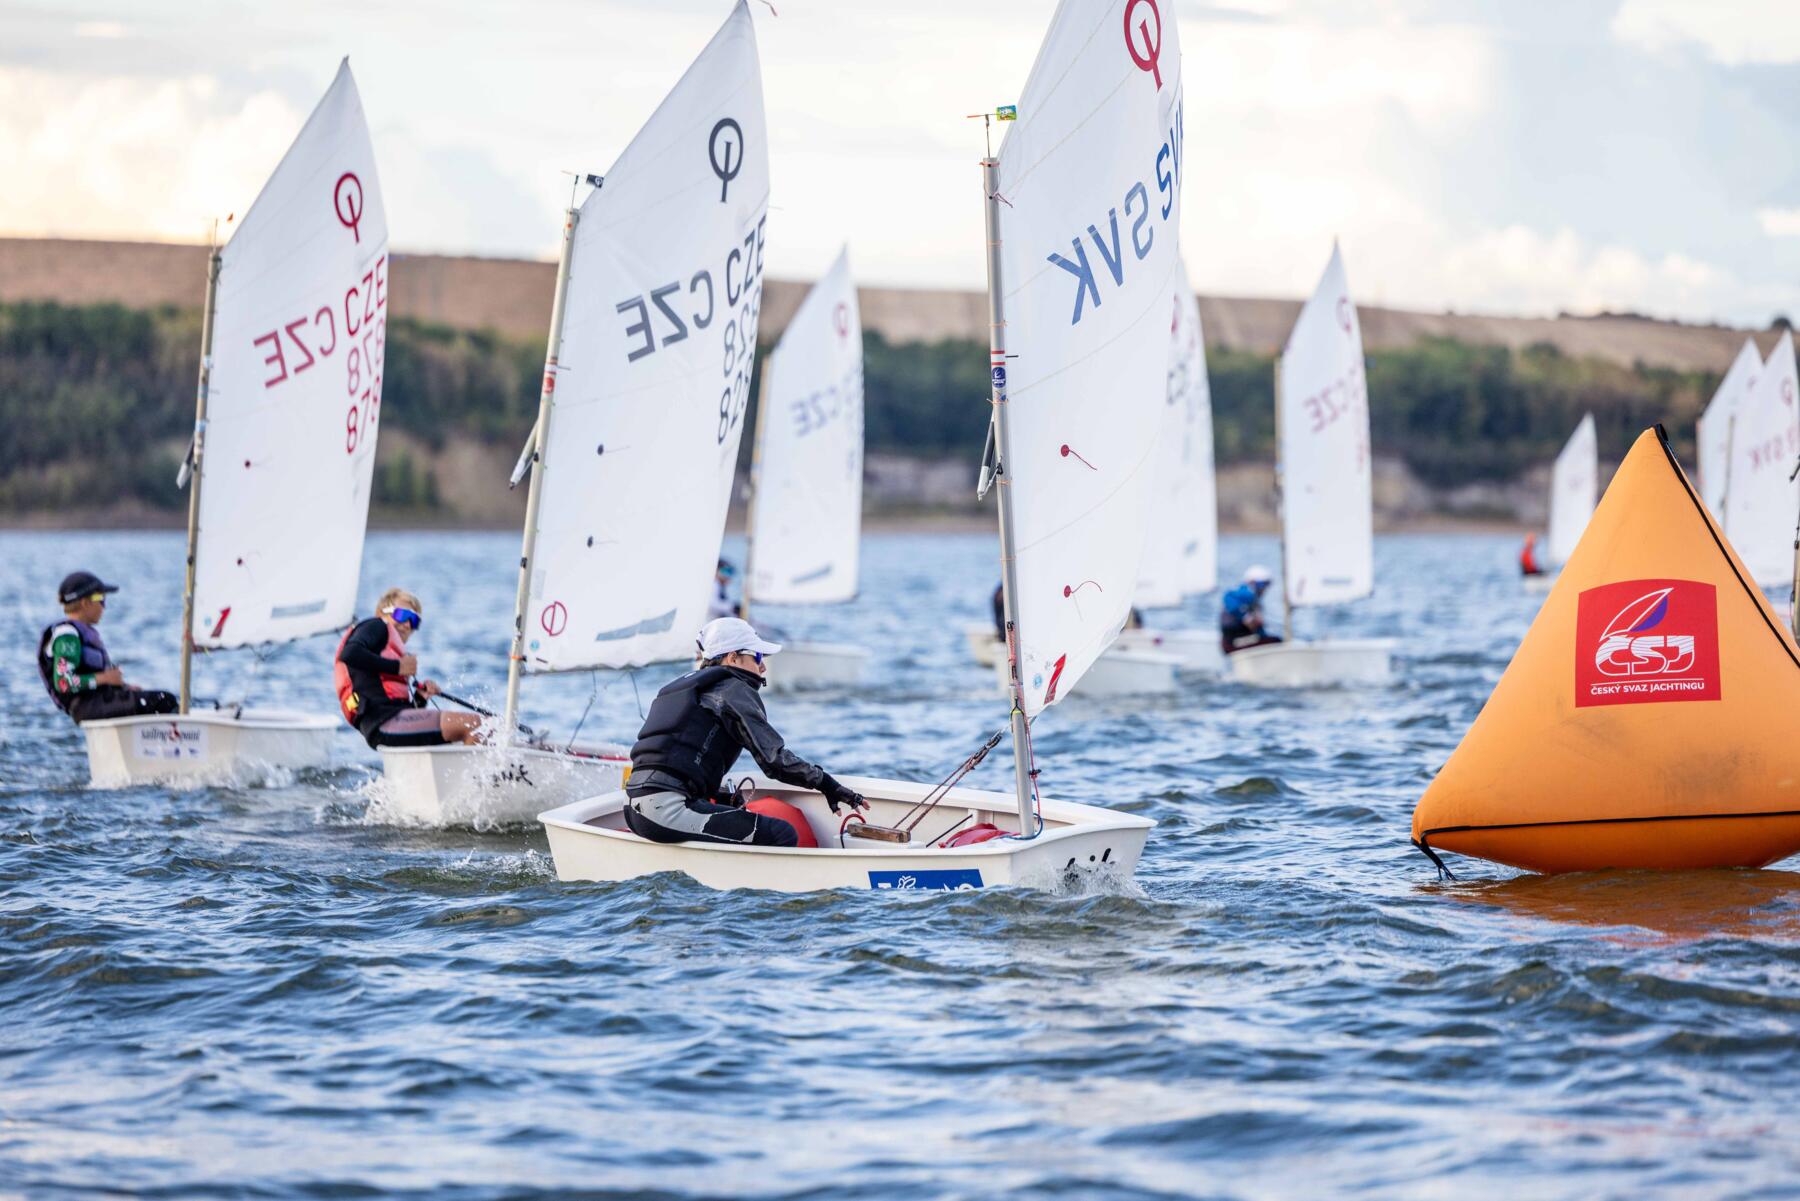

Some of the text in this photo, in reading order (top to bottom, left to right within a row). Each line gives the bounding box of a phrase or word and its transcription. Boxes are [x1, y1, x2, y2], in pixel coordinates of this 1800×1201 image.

[345, 256, 386, 336] CZE
[726, 215, 767, 307] CZE
[1591, 682, 1705, 696] ČESKÝ SVAZ JACHTINGU
